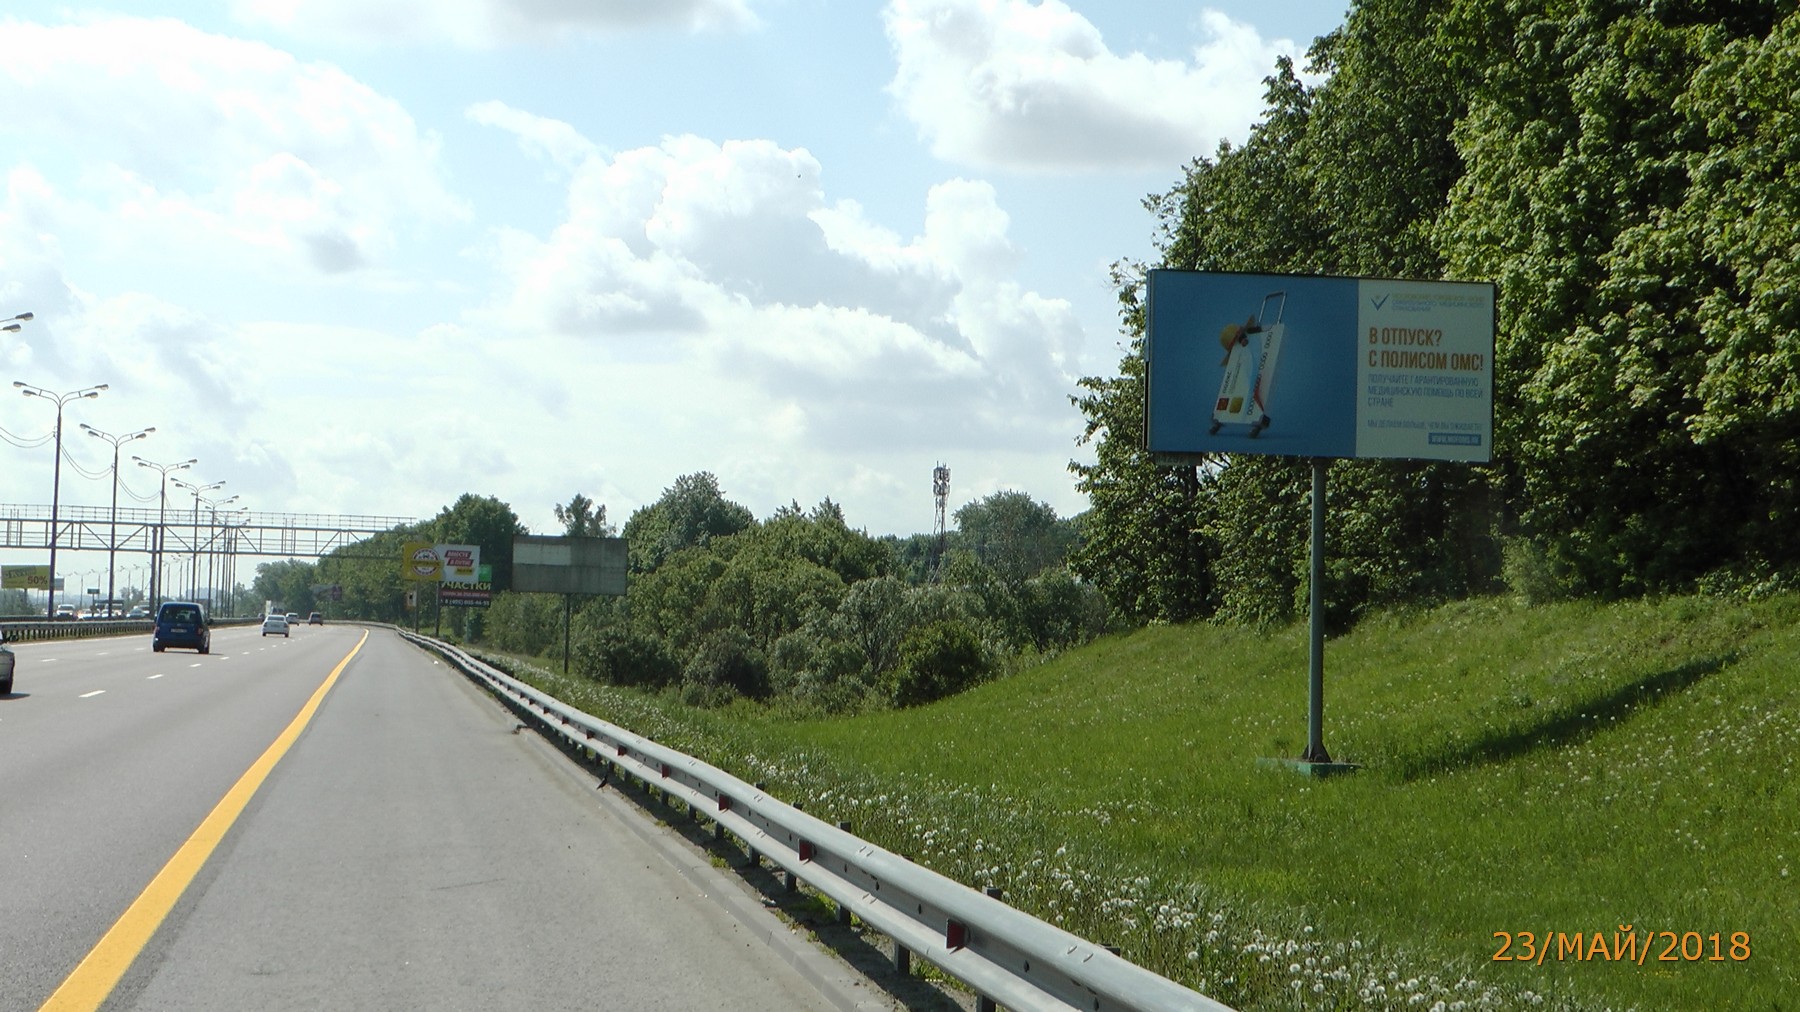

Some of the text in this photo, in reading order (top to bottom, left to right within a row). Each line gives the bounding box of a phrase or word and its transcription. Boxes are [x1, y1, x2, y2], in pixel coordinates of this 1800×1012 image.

[1369, 327, 1443, 347] В ОТПУСК?
[1369, 350, 1484, 371] С ПОЛИСОМ ОМС!
[1368, 373, 1479, 387] ПОЛУЧАЙТЕ ГАРАНТИРОВАННУЮ
[1368, 385, 1483, 398] МЕДИЦИНСКУЮ ПОМОЩЬ ПО ВСЕЙ
[1368, 397, 1393, 407] СТРАНЕ
[27, 575, 48, 584] 50%
